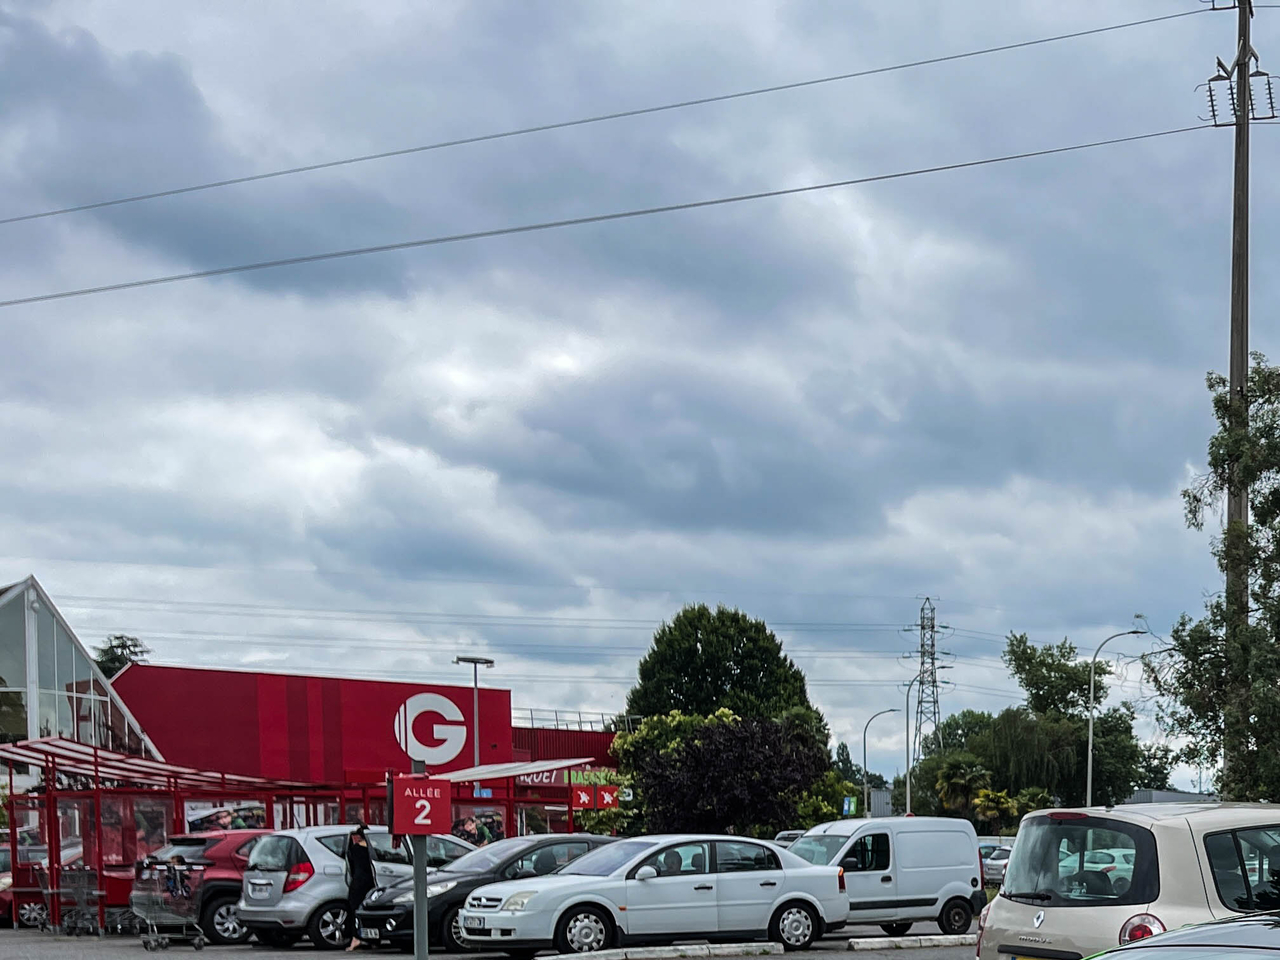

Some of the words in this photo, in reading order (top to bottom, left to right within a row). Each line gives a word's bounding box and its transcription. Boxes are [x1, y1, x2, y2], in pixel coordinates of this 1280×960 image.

[394, 692, 467, 765] G
[404, 787, 441, 798] ALLÉE
[414, 800, 431, 825] 2
